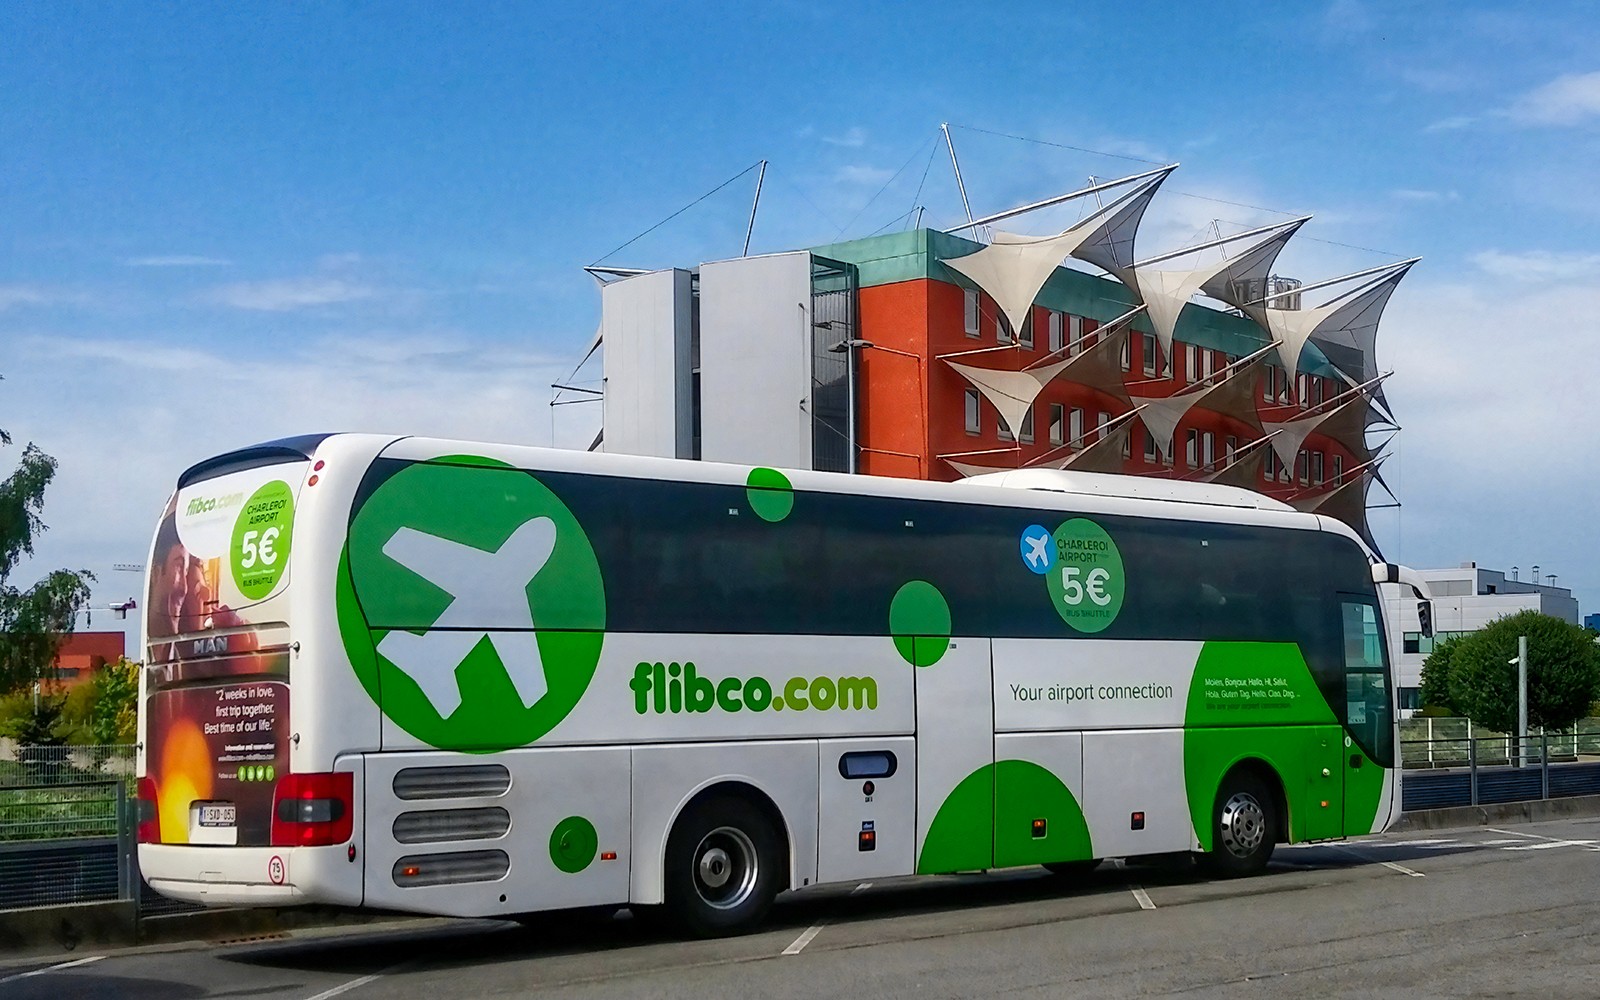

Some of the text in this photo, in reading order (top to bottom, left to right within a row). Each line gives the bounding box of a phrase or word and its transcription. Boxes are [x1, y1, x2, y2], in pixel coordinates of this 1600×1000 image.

[247, 499, 287, 515] CHARLEROI
[248, 511, 279, 525] AIRPORT
[1056, 538, 1109, 552] CHARLEROI
[1058, 551, 1098, 563] AIRPORT
[1061, 566, 1112, 606] 5€
[1066, 609, 1080, 617] BUS
[193, 636, 228, 654] MAN
[225, 688, 247, 700] weeks
[248, 687, 256, 698] in
[256, 687, 275, 698] love,
[629, 661, 878, 715] flibco.com
[1010, 683, 1173, 704] Your airport connection
[215, 705, 228, 717] first
[229, 705, 241, 718] trip
[204, 722, 219, 735] Best
[220, 722, 235, 733] time
[236, 720, 244, 732] of
[244, 721, 257, 732] our
[272, 862, 281, 873] 75
